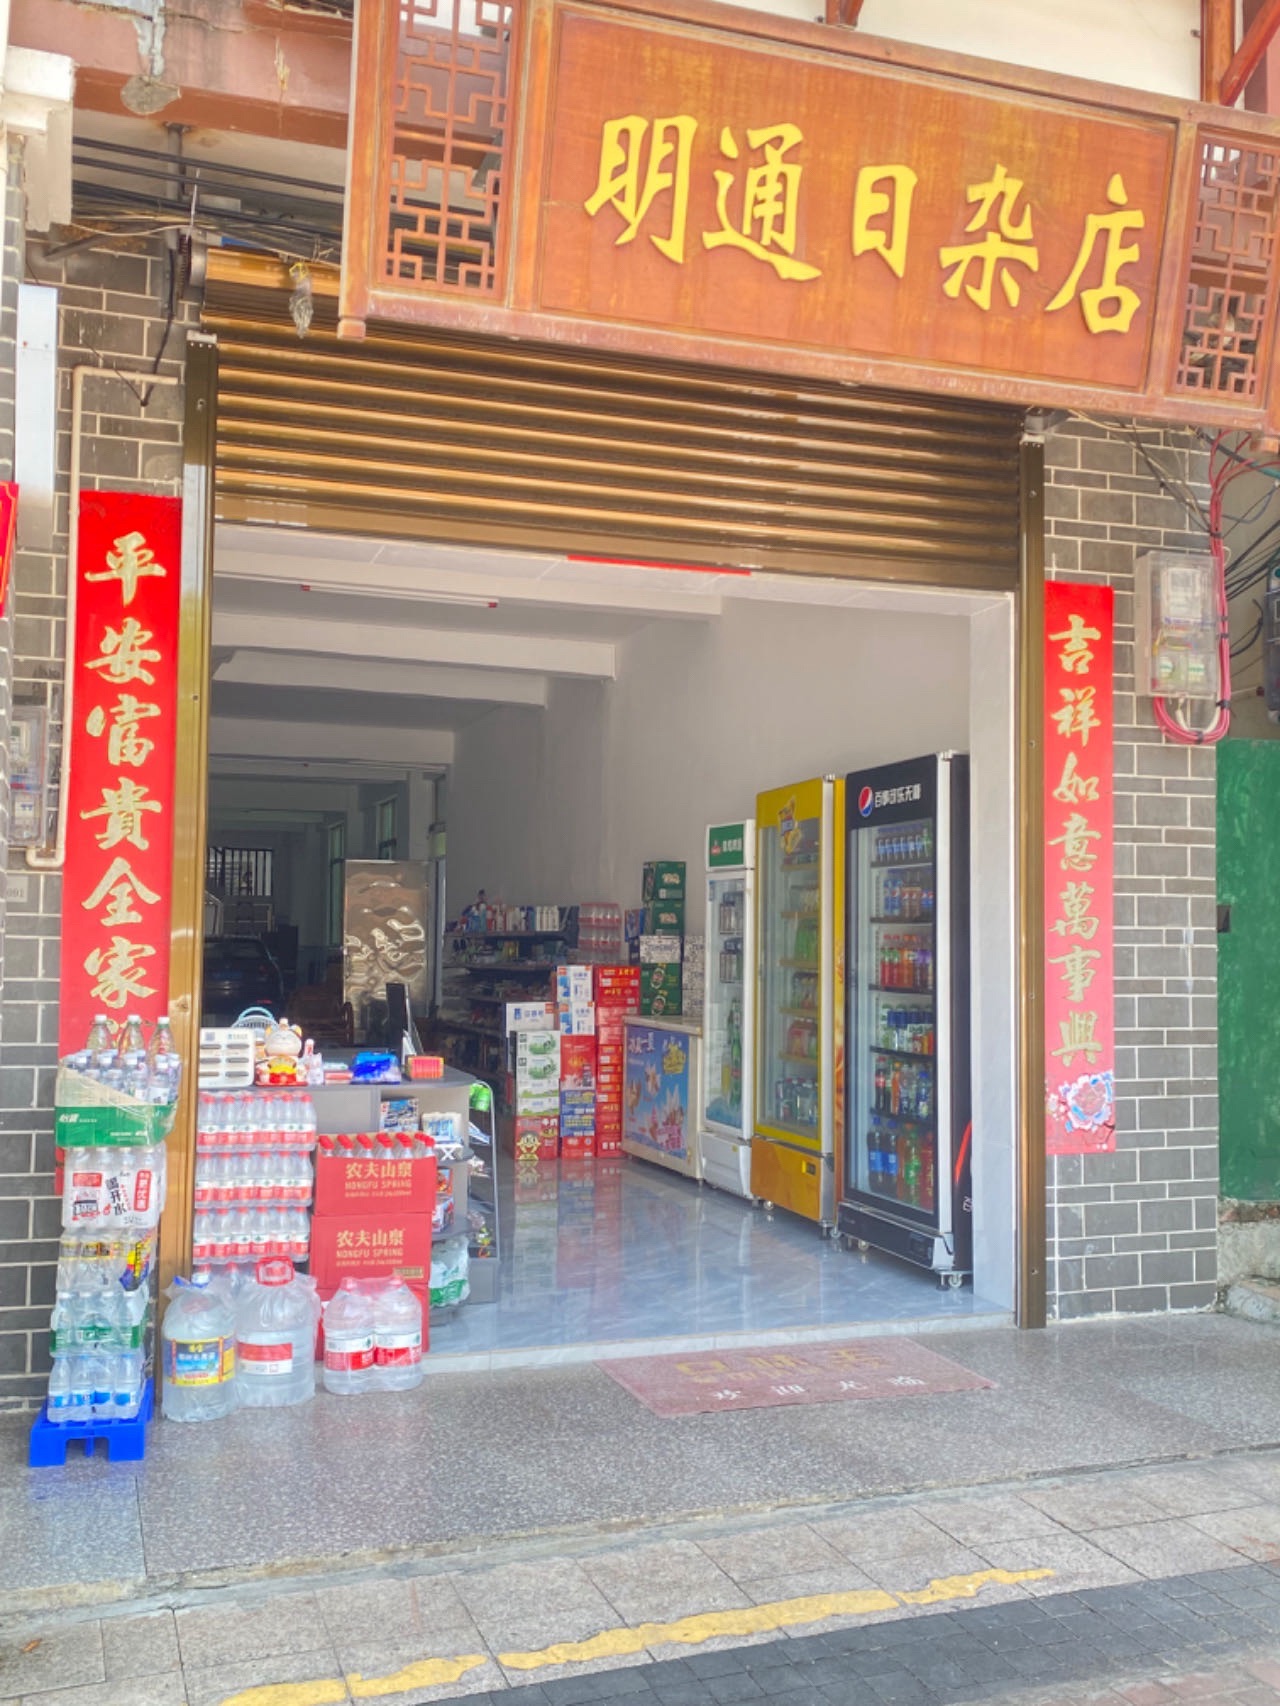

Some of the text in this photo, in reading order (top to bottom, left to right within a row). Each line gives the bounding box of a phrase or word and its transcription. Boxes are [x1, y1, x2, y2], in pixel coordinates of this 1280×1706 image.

[584, 115, 1145, 333] 明通日杂店
[81, 531, 167, 1048] 平安富貴全家
[1049, 614, 1103, 1067] 吉祥如意萬事興
[346, 1161, 412, 1179] 农夫山泉
[345, 1179, 412, 1190] NONGFU SPRING
[337, 1229, 404, 1249] 农夫山泉
[336, 1248, 404, 1259] NONGFU SPRING
